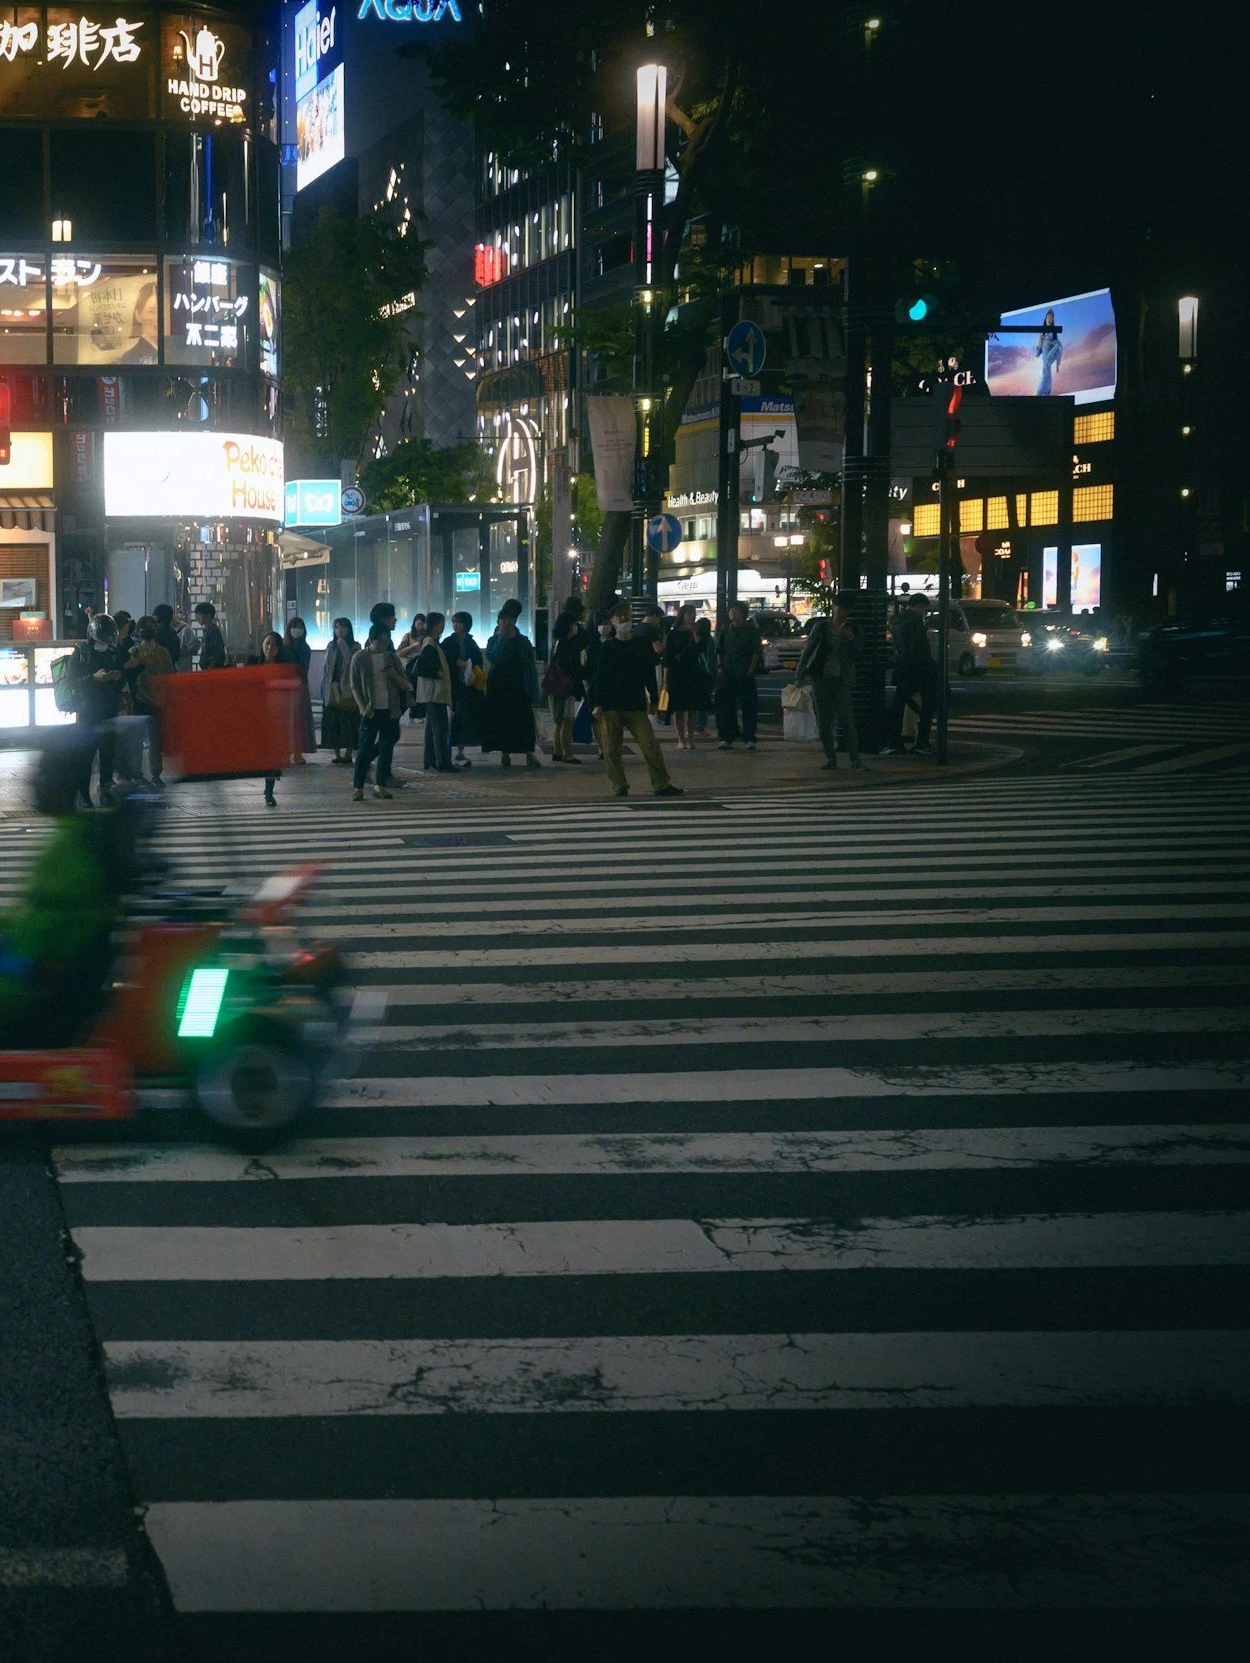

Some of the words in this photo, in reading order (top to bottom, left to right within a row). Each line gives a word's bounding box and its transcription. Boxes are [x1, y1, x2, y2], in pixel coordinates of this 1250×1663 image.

[294, 6, 336, 80] Haier
[168, 79, 210, 98] HAND
[212, 86, 246, 104] DRIP
[180, 97, 235, 118] COFFEE
[173, 292, 249, 318] ハンバーグ
[185, 322, 239, 348] 不二家
[223, 441, 267, 476] Peko
[231, 480, 277, 512] House
[667, 489, 689, 508] Health
[696, 489, 719, 505] Beauty
